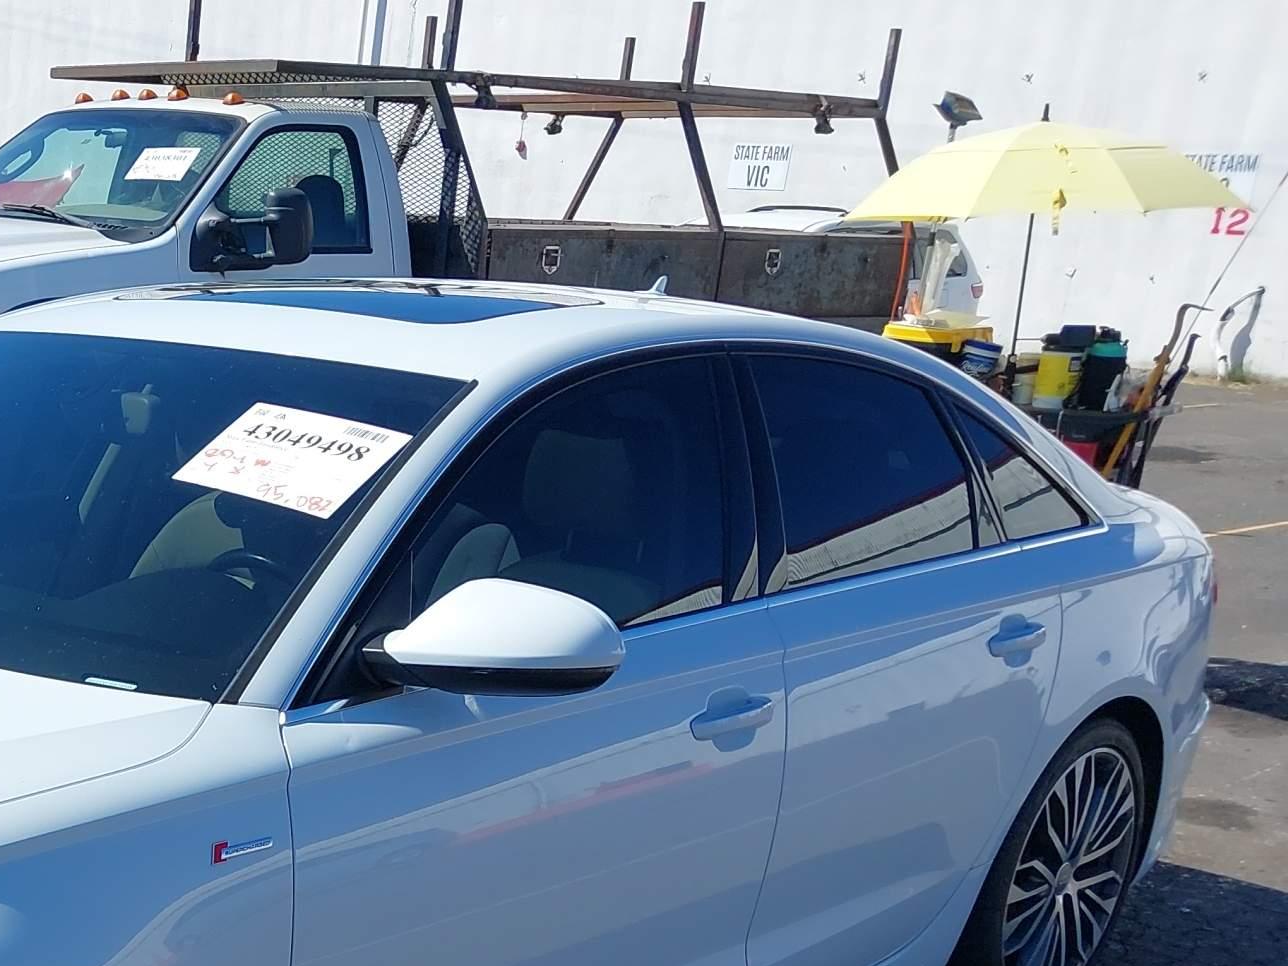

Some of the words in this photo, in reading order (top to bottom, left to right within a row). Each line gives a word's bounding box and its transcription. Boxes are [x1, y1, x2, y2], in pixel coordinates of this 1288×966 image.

[734, 144, 761, 161] STATE
[761, 145, 790, 161] FARM
[1218, 153, 1259, 173] FARM
[746, 164, 770, 188] VIC
[1210, 206, 1250, 236] 12
[243, 423, 371, 462] 43049498
